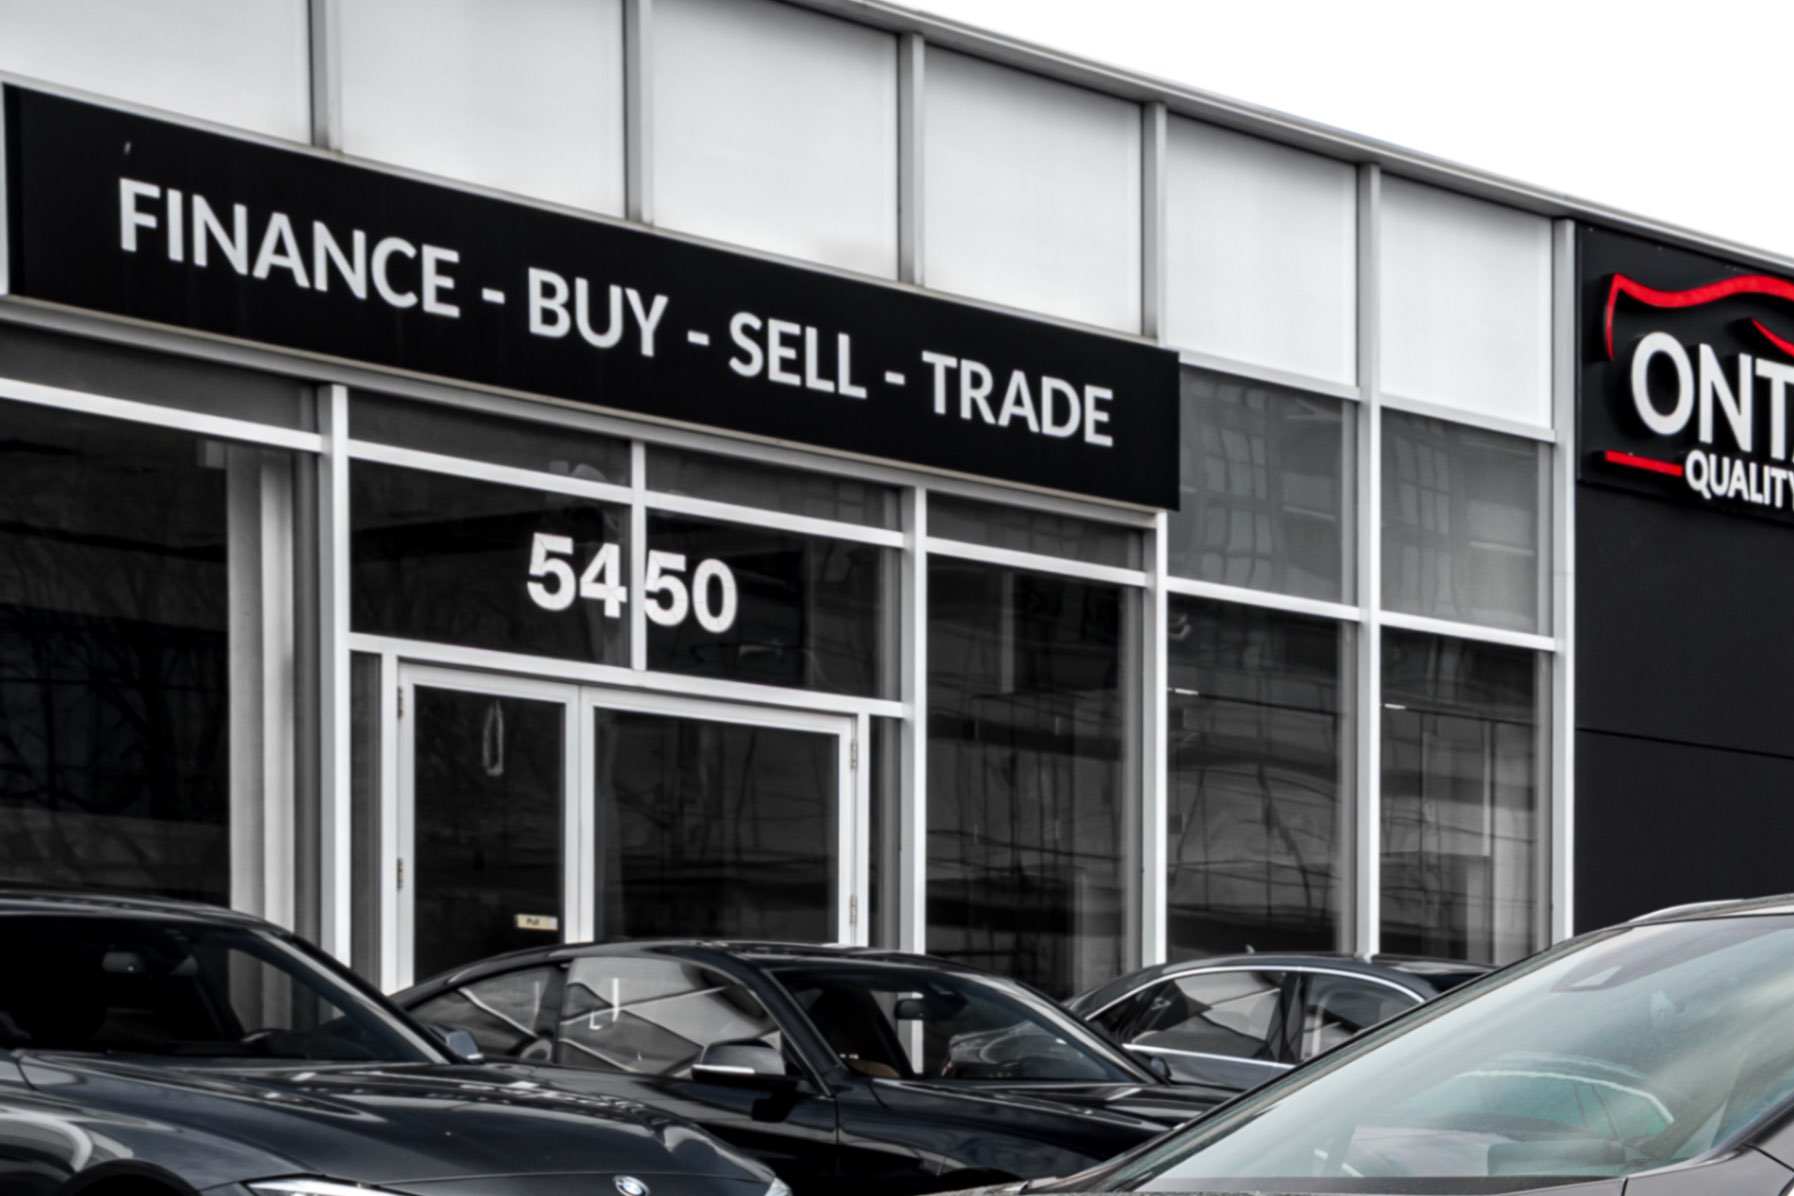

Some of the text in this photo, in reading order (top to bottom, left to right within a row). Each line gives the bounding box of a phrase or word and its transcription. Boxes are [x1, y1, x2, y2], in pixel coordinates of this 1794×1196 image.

[117, 176, 462, 319] FINANCE
[527, 266, 669, 357] BUY
[728, 311, 868, 400] SELL
[920, 350, 1115, 448] TRADE
[525, 532, 739, 634] 5450
